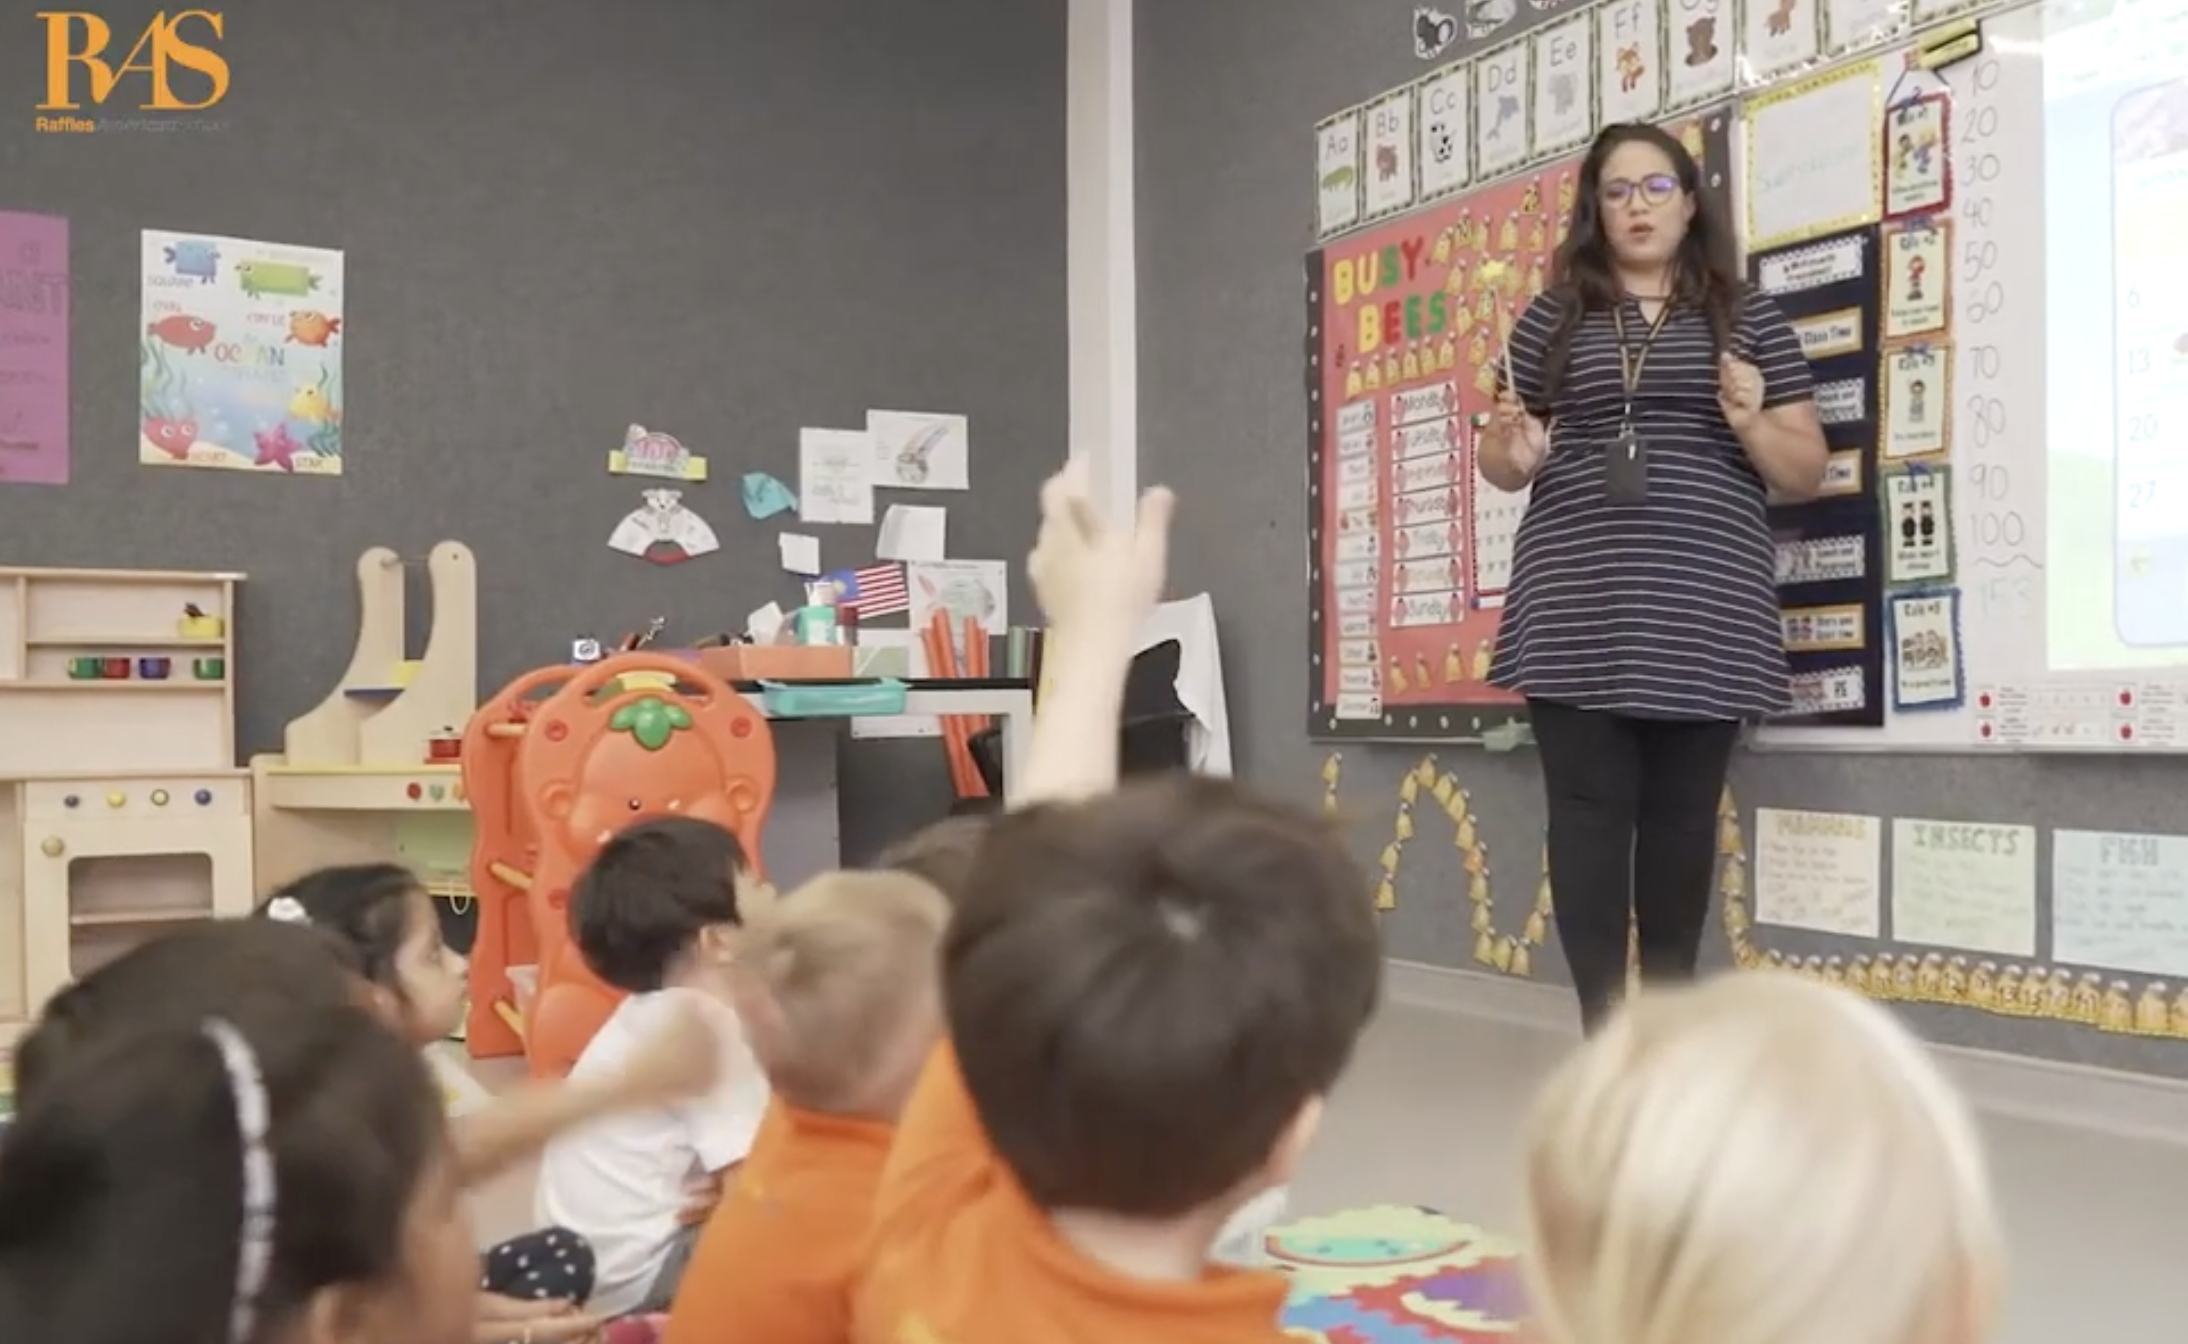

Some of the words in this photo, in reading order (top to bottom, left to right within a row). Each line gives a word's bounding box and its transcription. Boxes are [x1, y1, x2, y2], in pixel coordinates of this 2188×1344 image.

[1550, 37, 1577, 67] Ee
[1488, 63, 1517, 92] Dd
[1971, 59, 1999, 97] 10
[1430, 88, 1456, 116] Cc
[1376, 110, 1399, 136] Bb
[1961, 105, 1998, 143] 20
[1326, 132, 1348, 161] Aa
[1961, 153, 2000, 186] 30
[1963, 197, 1993, 228] 40
[1333, 236, 1424, 305] BUSY
[1963, 240, 1998, 283] 50
[2126, 284, 2141, 309] 6
[1358, 290, 1447, 353] BEES
[1968, 344, 1999, 380] 70
[2127, 347, 2151, 375] 13
[1967, 394, 2005, 449] 80
[2127, 412, 2159, 442] 20
[1968, 463, 2009, 501] 90
[2128, 479, 2157, 509] 27
[1970, 510, 2025, 547] 100
